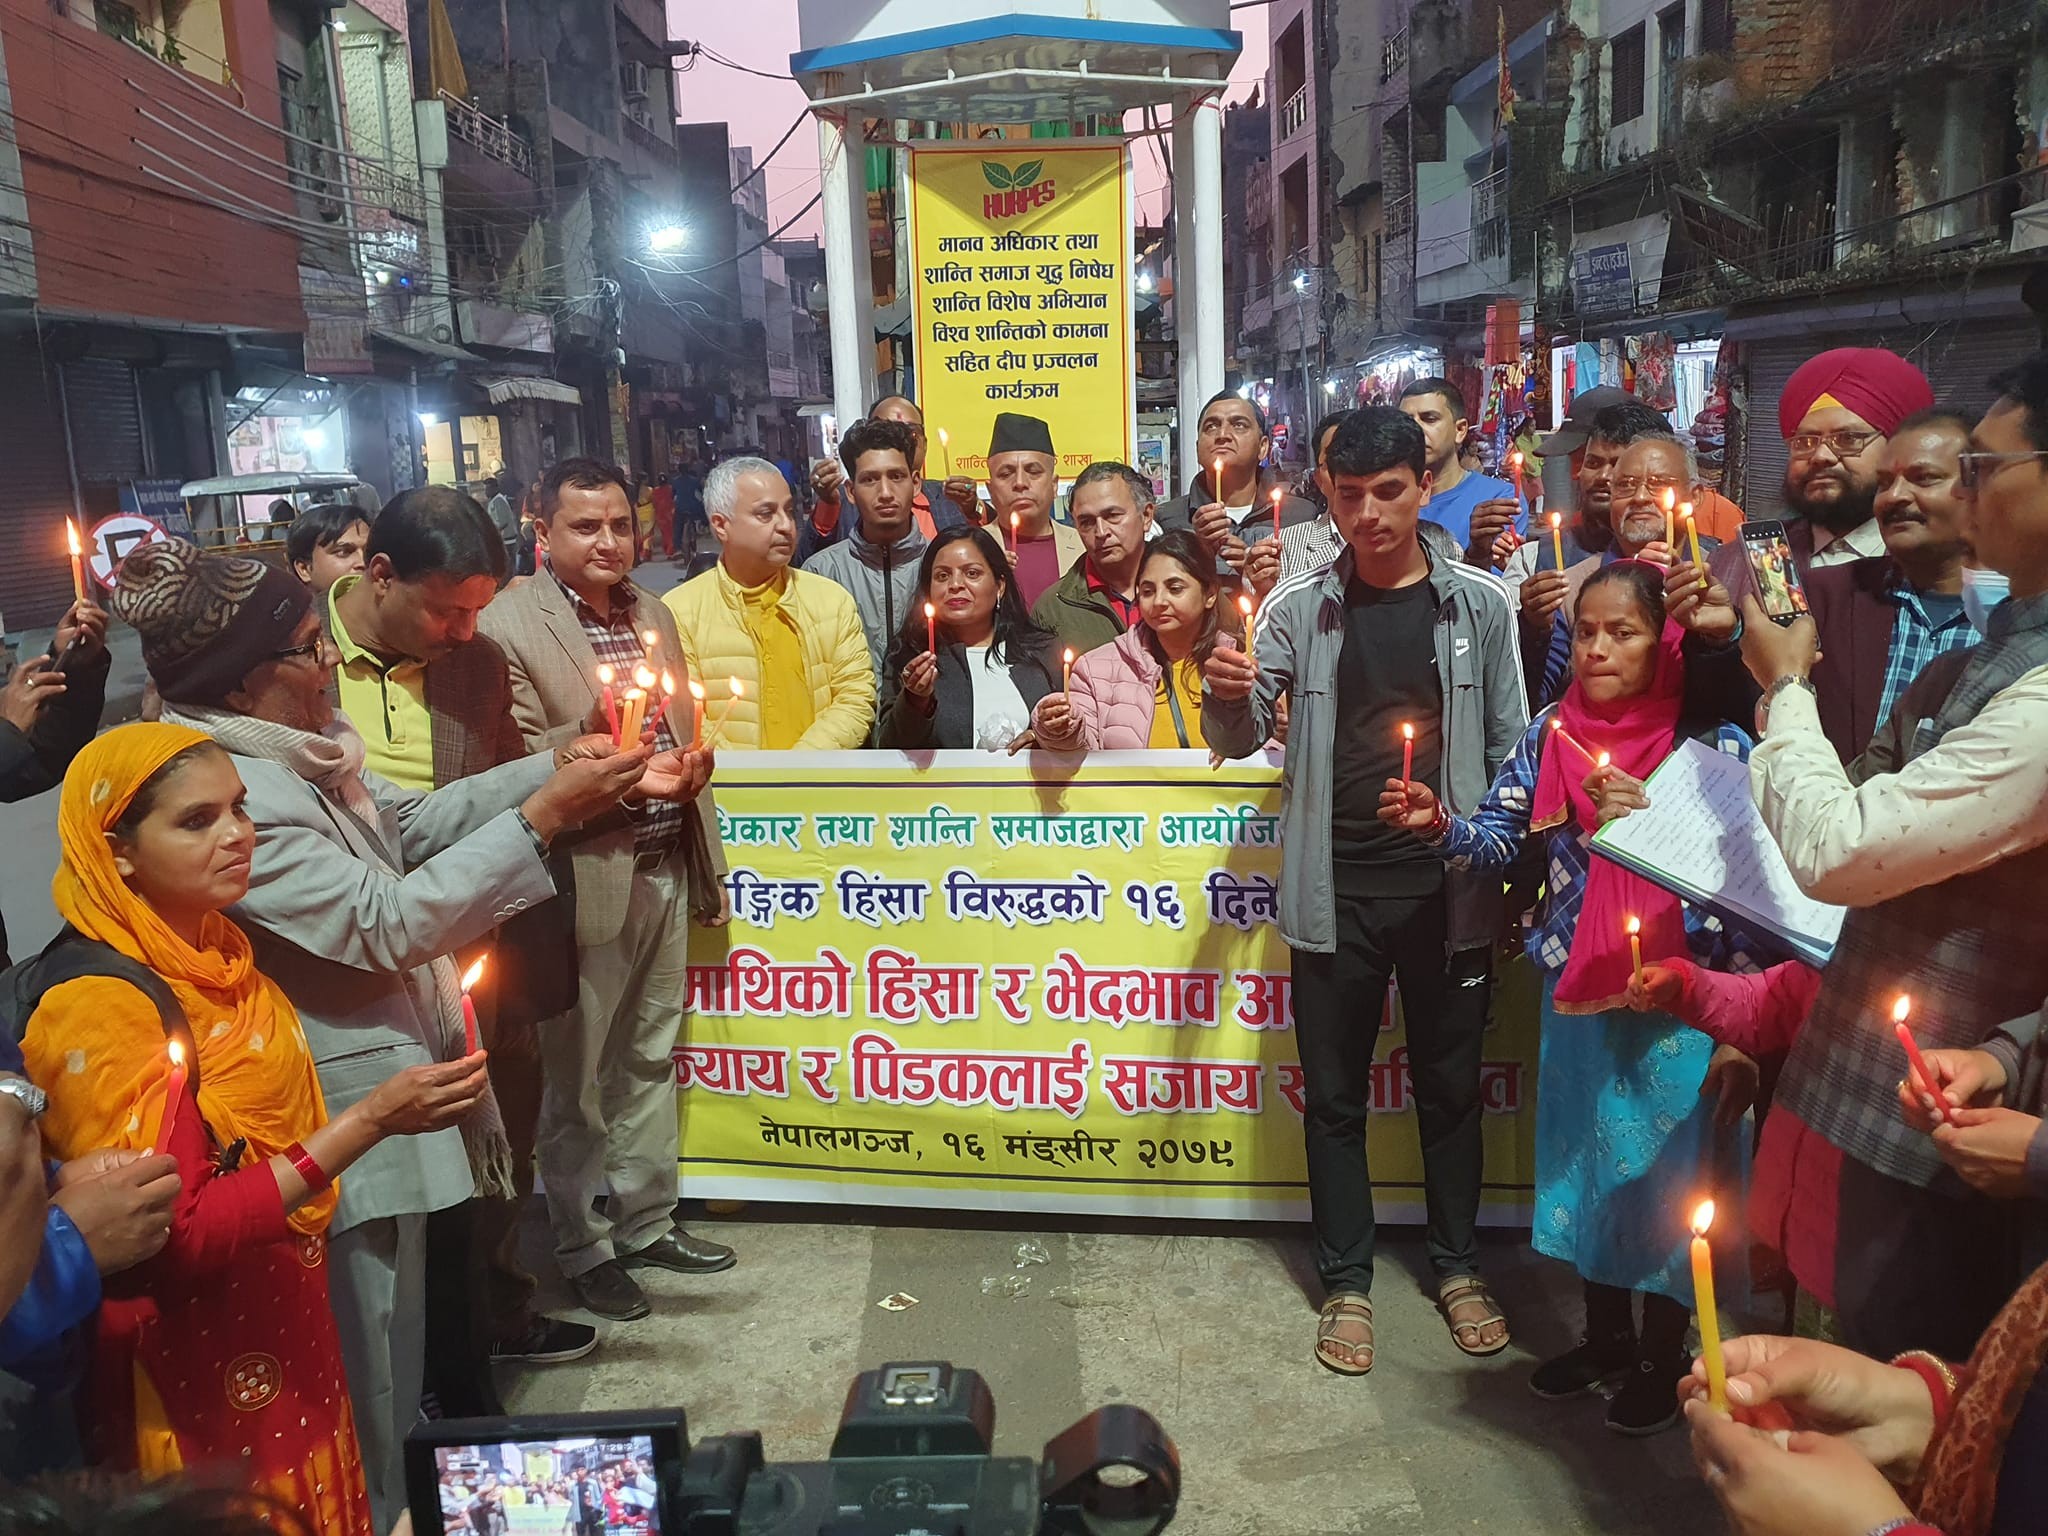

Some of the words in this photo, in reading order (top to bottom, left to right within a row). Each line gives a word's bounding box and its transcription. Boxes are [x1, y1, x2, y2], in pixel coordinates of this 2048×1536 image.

[939, 236, 984, 252] मानव
[990, 231, 1060, 251] अधिकार
[1065, 234, 1099, 250] तथा
[924, 262, 972, 284] शान्ति
[979, 265, 1030, 283] समाज
[1069, 258, 1115, 279] निषेध
[932, 291, 981, 313] शान्ति
[987, 290, 1032, 311] विशेष
[1038, 289, 1108, 310] अभियान
[933, 322, 970, 343] विश्व
[975, 319, 1047, 342] शान्तिको
[1053, 323, 1109, 339] कामना
[945, 351, 990, 372] सहित
[996, 350, 1027, 370] दीप
[1033, 352, 1099, 371] प्रज्वलन
[985, 379, 1060, 400] कार्यक्रम
[1064, 454, 1093, 467] शाखा
[718, 806, 802, 848] धिकार
[816, 816, 874, 844] तथा
[889, 805, 977, 846] शान्ति
[991, 815, 1145, 849] समाजद्वारा
[1160, 805, 1282, 845] आयोजि
[724, 870, 819, 924] ङ्गिक
[837, 870, 928, 922] हिंसा
[944, 870, 1106, 923] विरुद्धको
[1126, 884, 1181, 924] १६
[866, 949, 979, 1020] हिंसा
[995, 968, 1031, 1019] र
[1046, 953, 1220, 1024] भेदभाव
[802, 1052, 837, 1099] र
[852, 1034, 1089, 1114] पिडकलाई
[1104, 1058, 1263, 1113] सजाय
[942, 1132, 987, 1162] १६
[1137, 1138, 1234, 1169] २०७९
